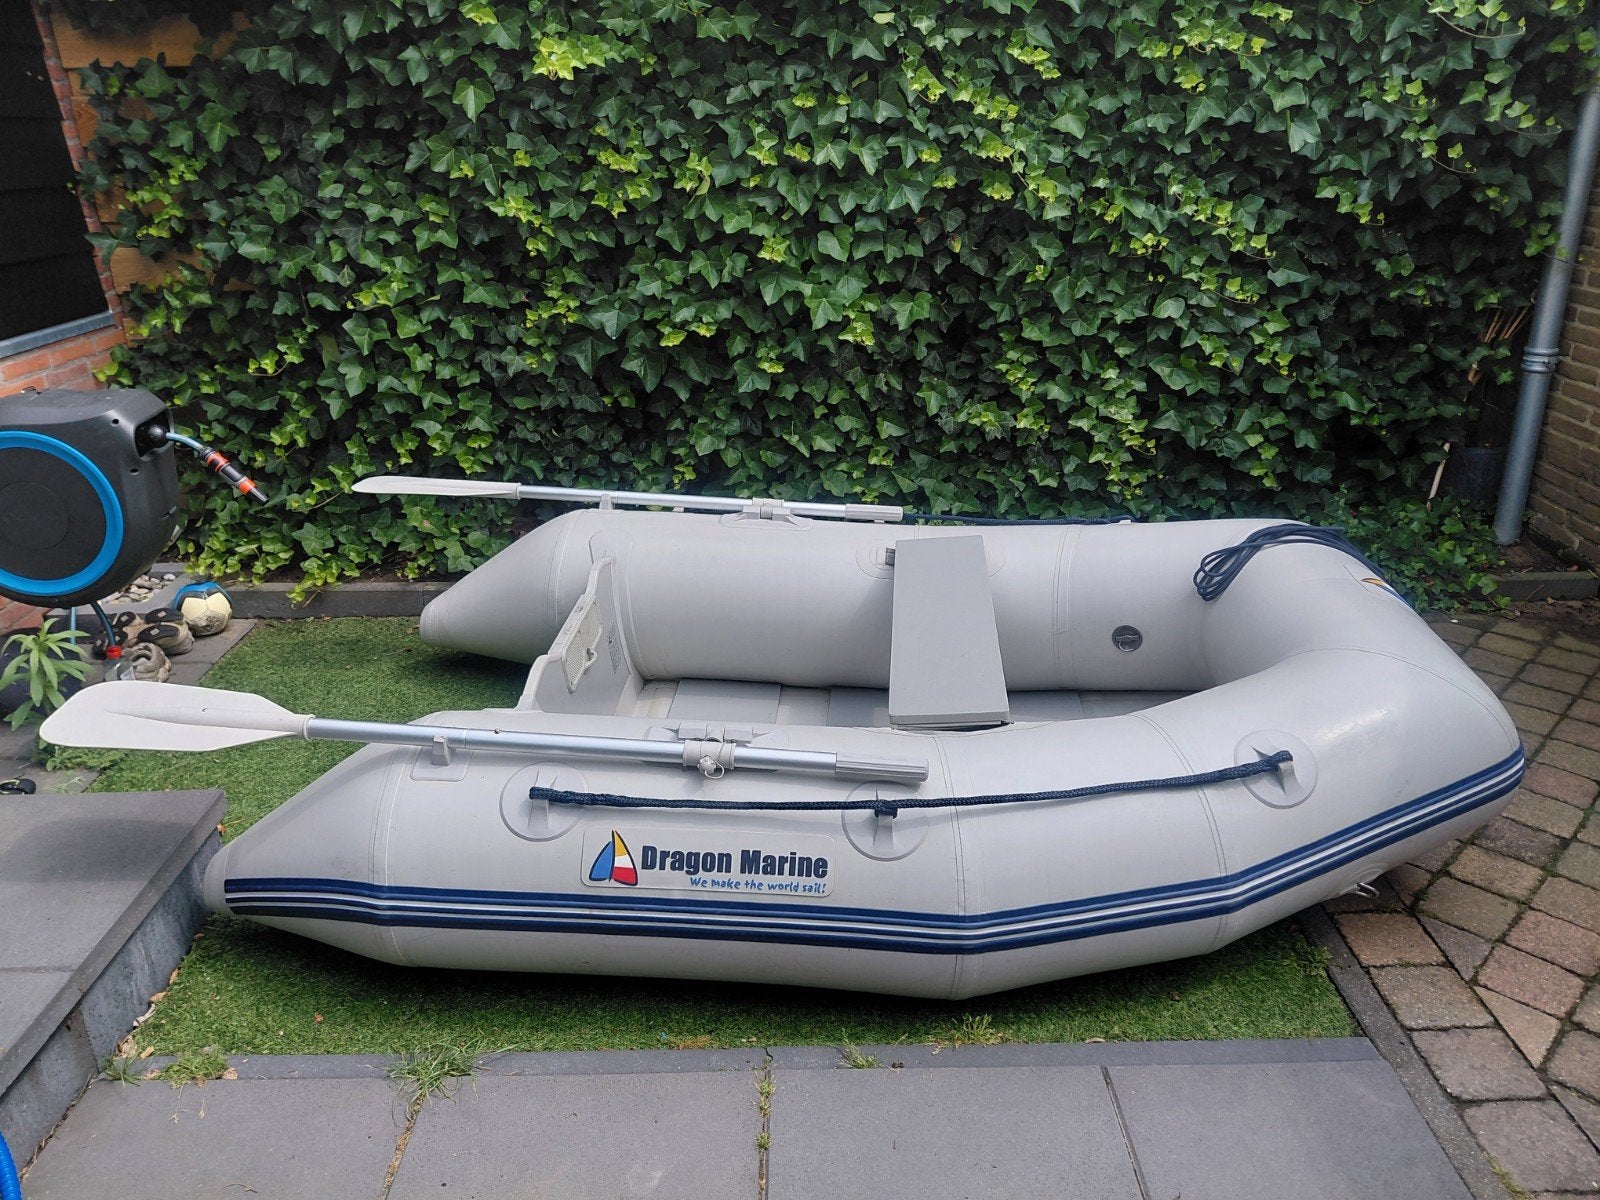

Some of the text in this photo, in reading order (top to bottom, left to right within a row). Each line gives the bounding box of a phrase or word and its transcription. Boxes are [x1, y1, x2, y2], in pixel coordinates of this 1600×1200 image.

[641, 845, 828, 878] Dragon Marine
[690, 877, 826, 894] We make the world sail!
